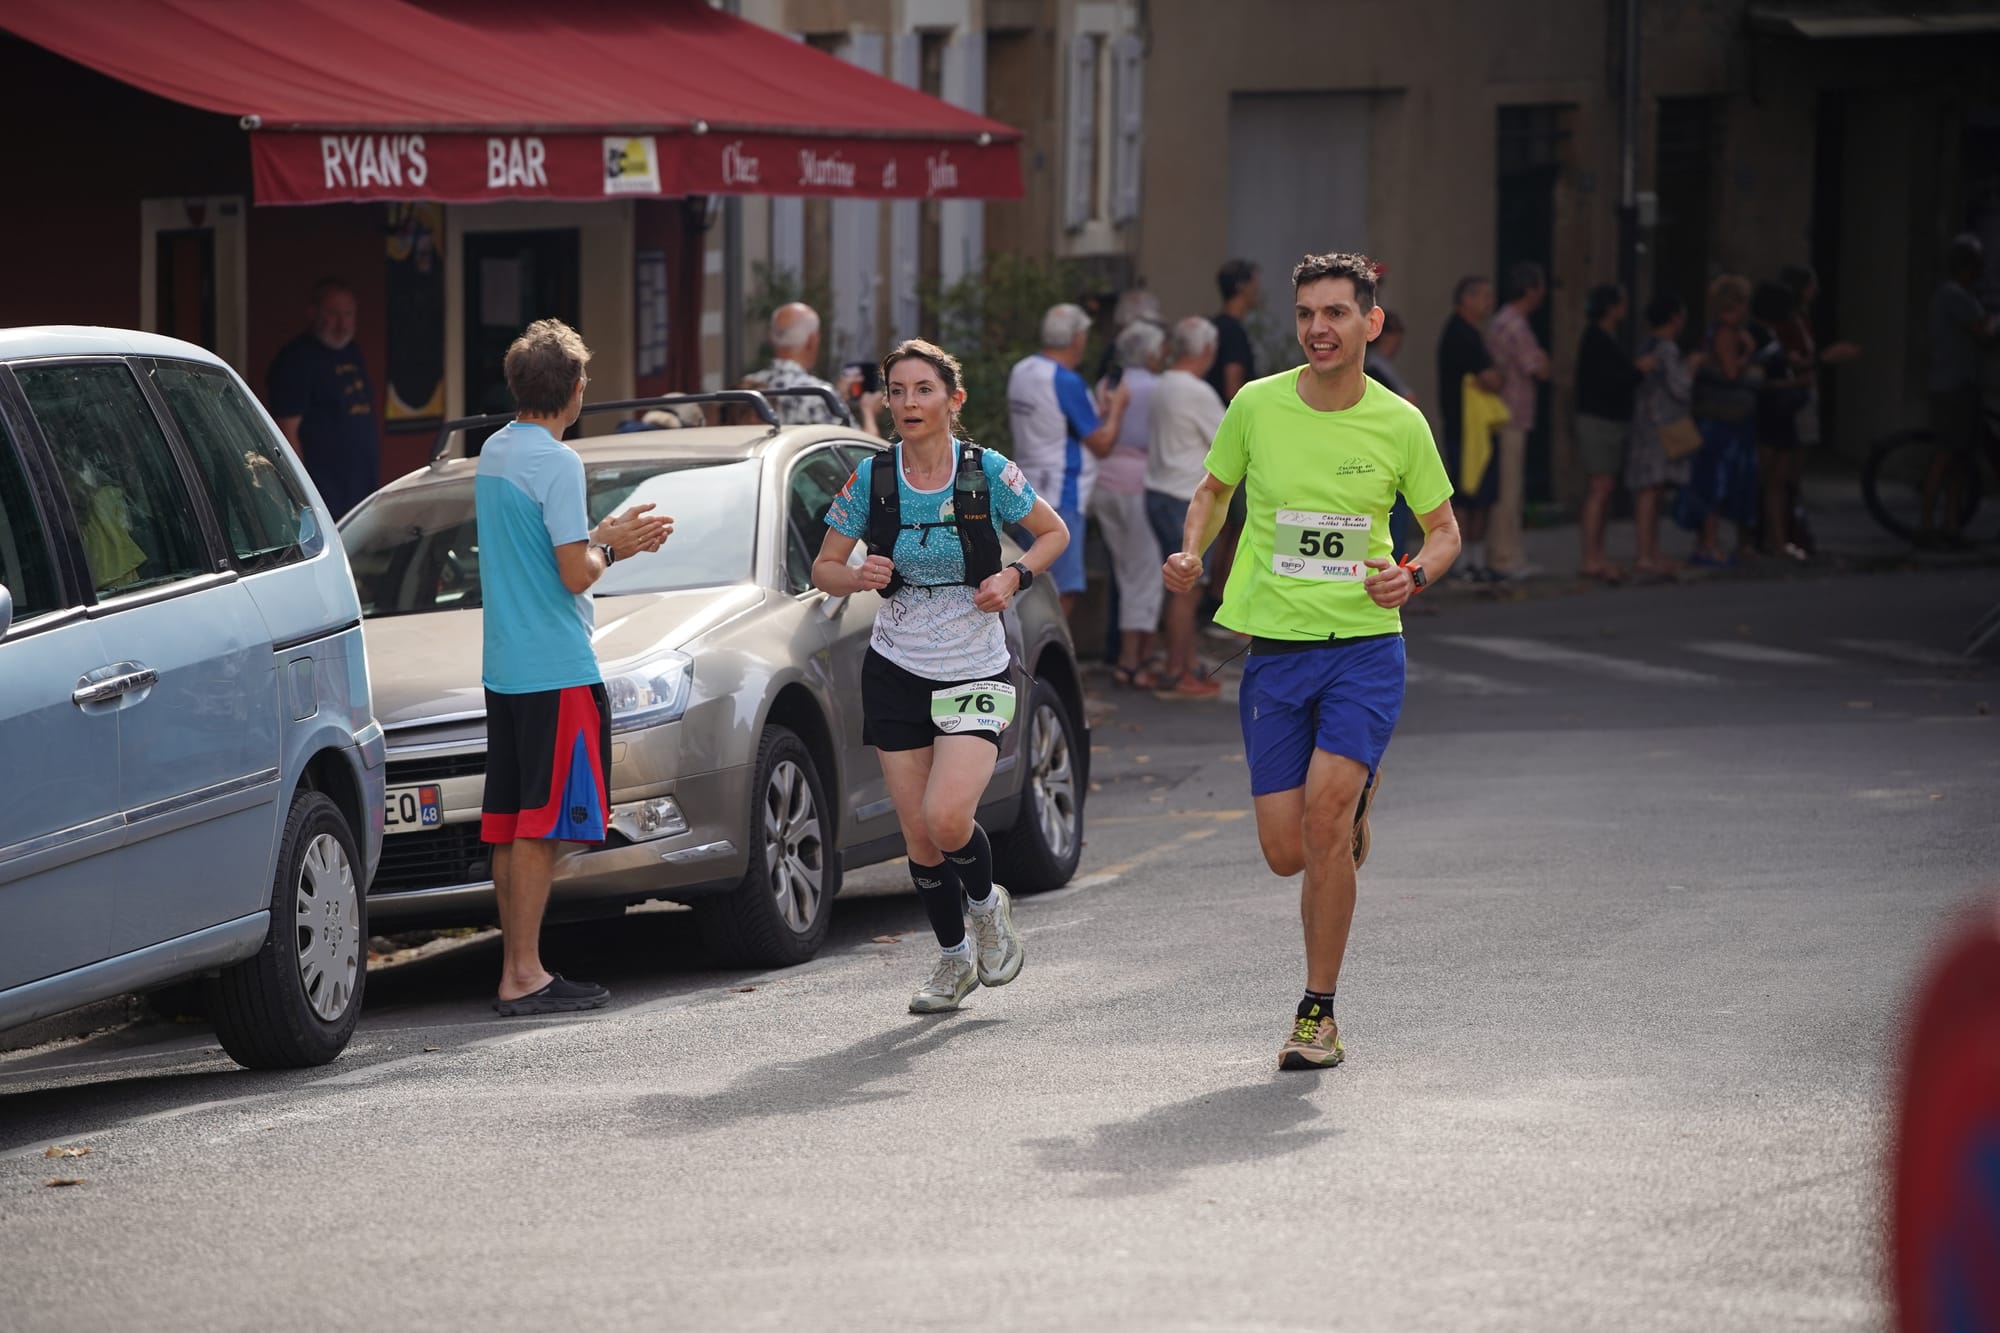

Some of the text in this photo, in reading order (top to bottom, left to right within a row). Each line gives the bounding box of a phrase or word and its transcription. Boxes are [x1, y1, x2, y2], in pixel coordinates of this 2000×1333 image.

[321, 135, 428, 188] RYAN'S
[487, 138, 548, 188] BAR
[722, 141, 759, 185] Chez
[799, 150, 856, 187] Martine
[1298, 530, 1344, 558] 56
[954, 693, 995, 714] 76
[422, 807, 438, 822] 48
